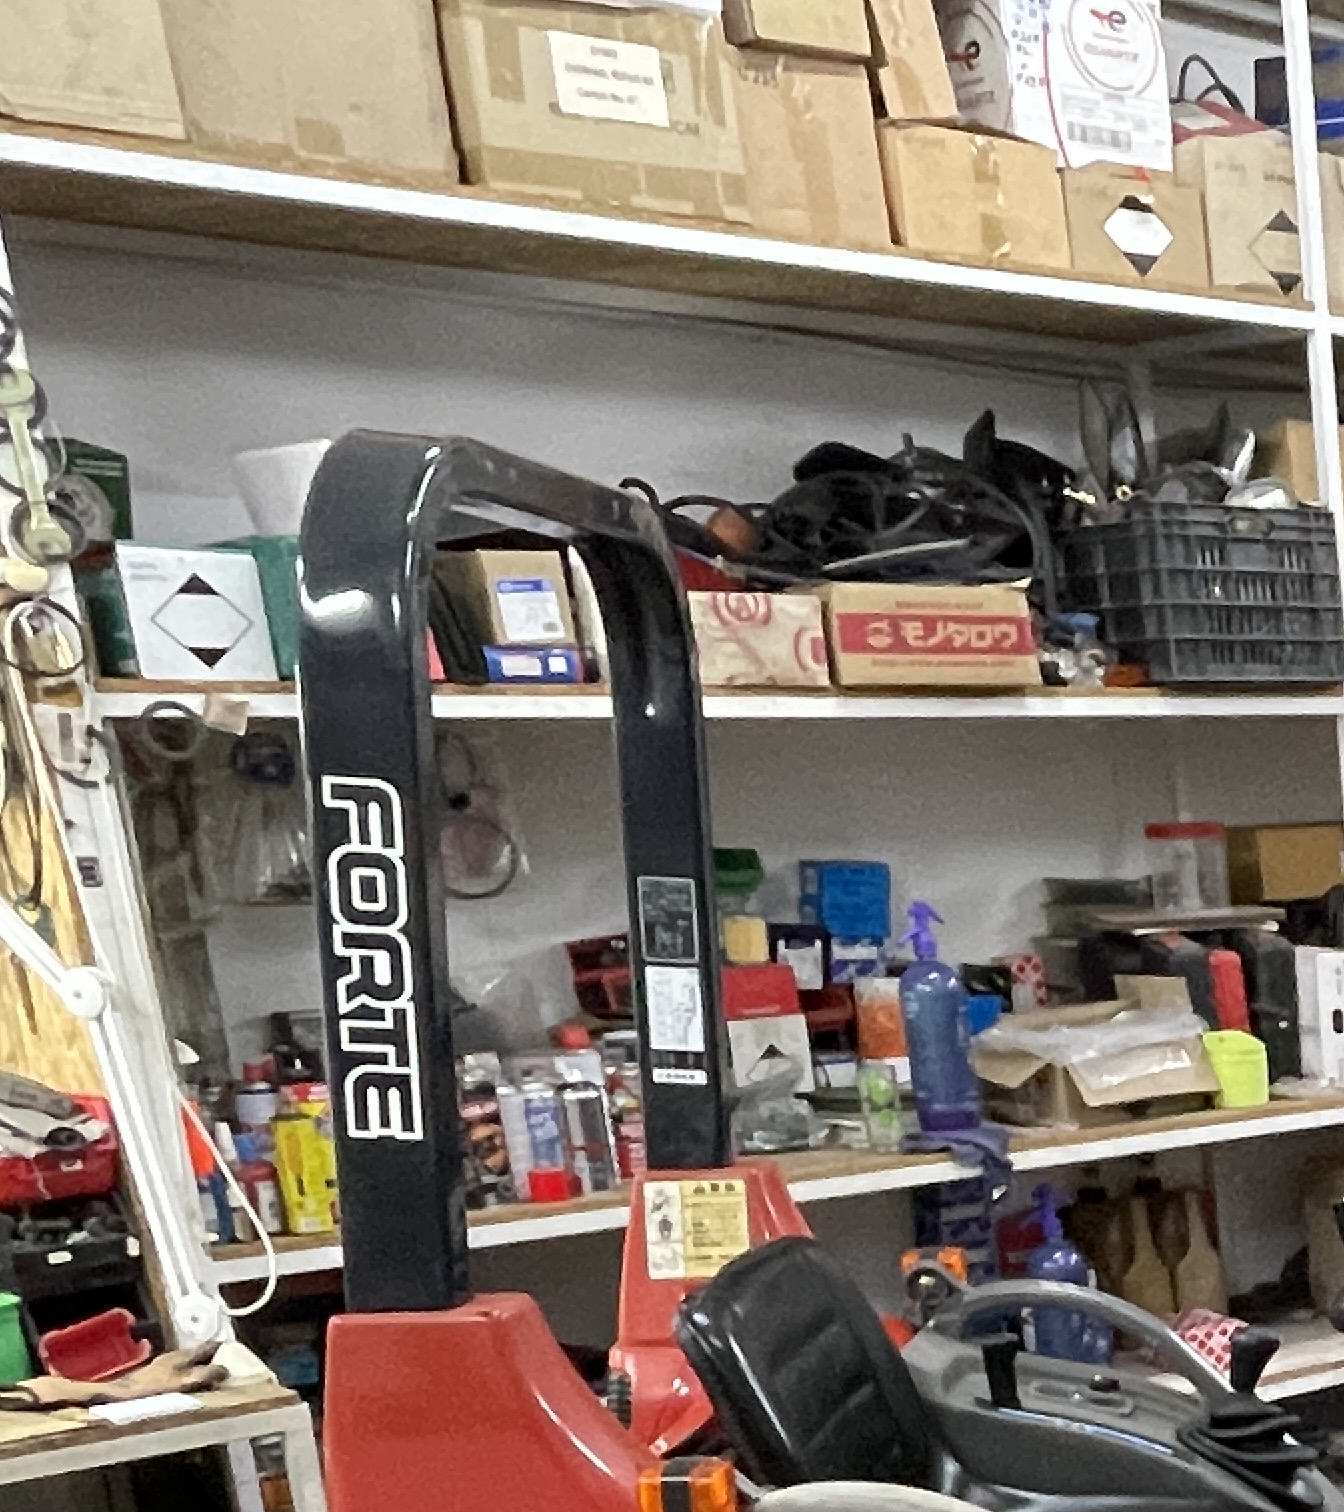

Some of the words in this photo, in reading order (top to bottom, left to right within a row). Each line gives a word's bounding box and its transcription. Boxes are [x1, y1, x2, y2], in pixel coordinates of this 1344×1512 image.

[899, 619, 1019, 649] モノタロウ
[321, 774, 424, 1141] FORTE
